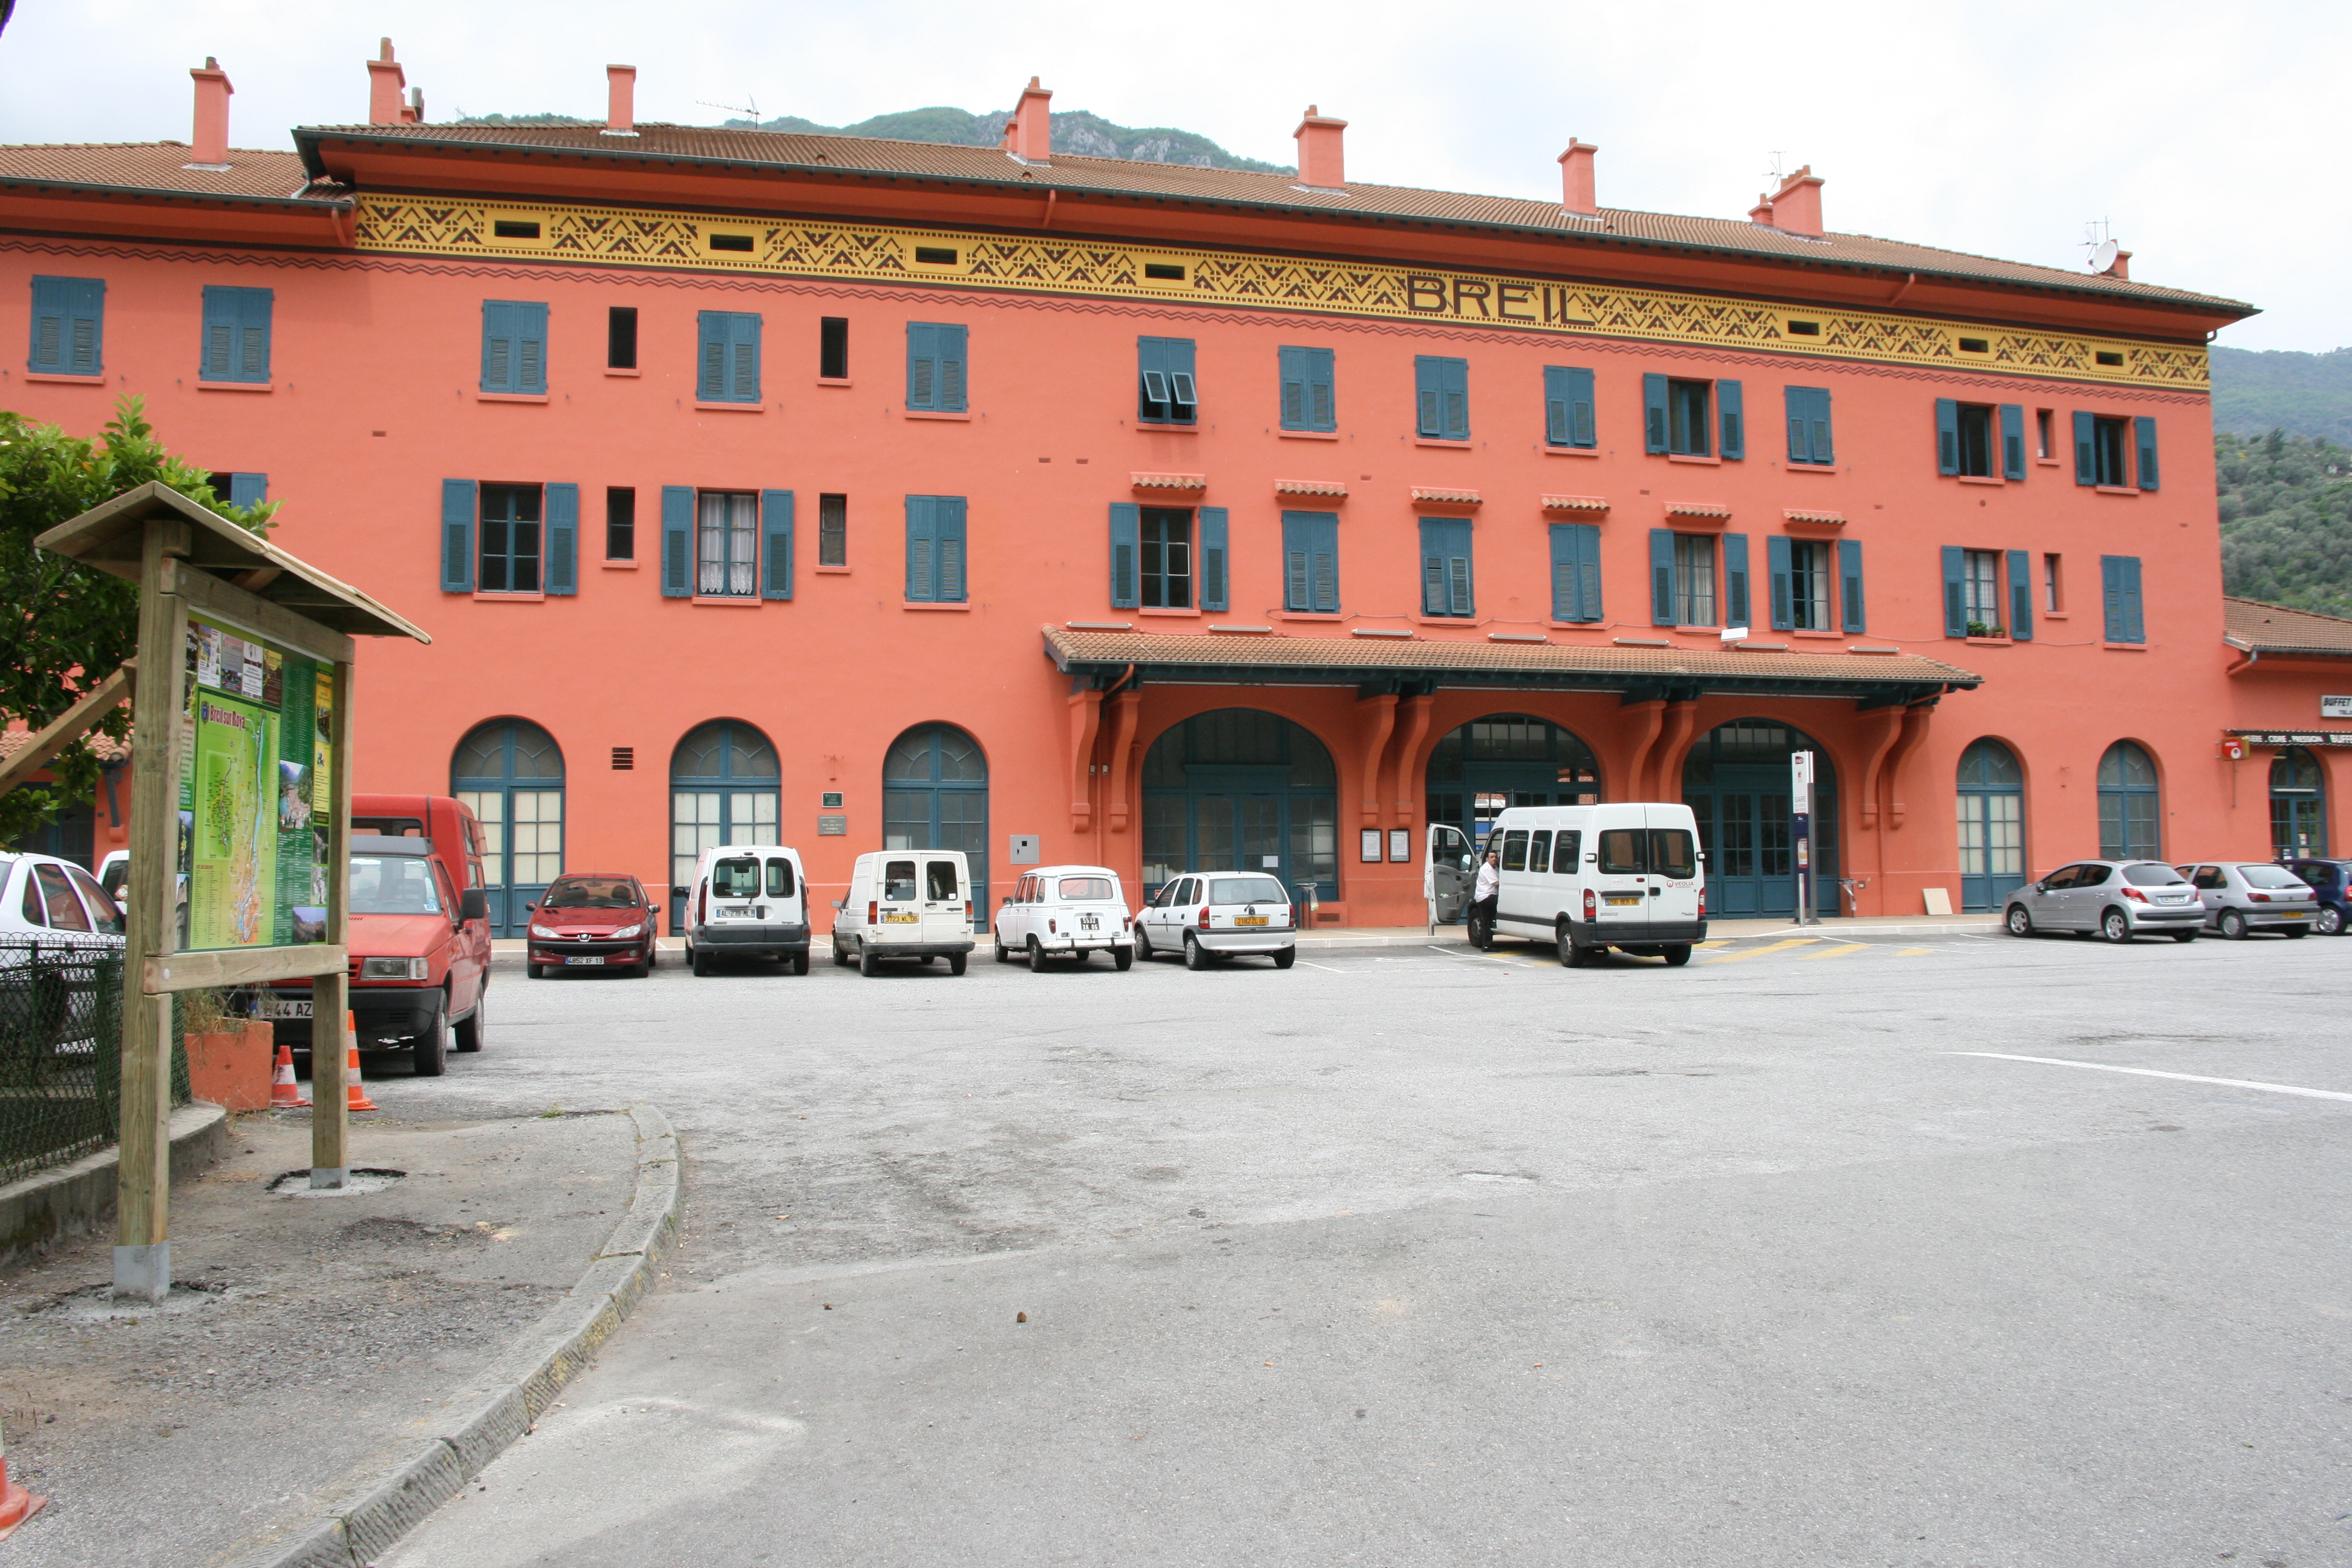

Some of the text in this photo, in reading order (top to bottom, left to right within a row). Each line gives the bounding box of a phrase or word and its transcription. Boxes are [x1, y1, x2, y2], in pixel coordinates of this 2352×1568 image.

[1406, 274, 1596, 327] BREIL
[210, 704, 223, 724] Breil
[232, 711, 245, 731] Roya
[296, 1002, 312, 1016] AZ
